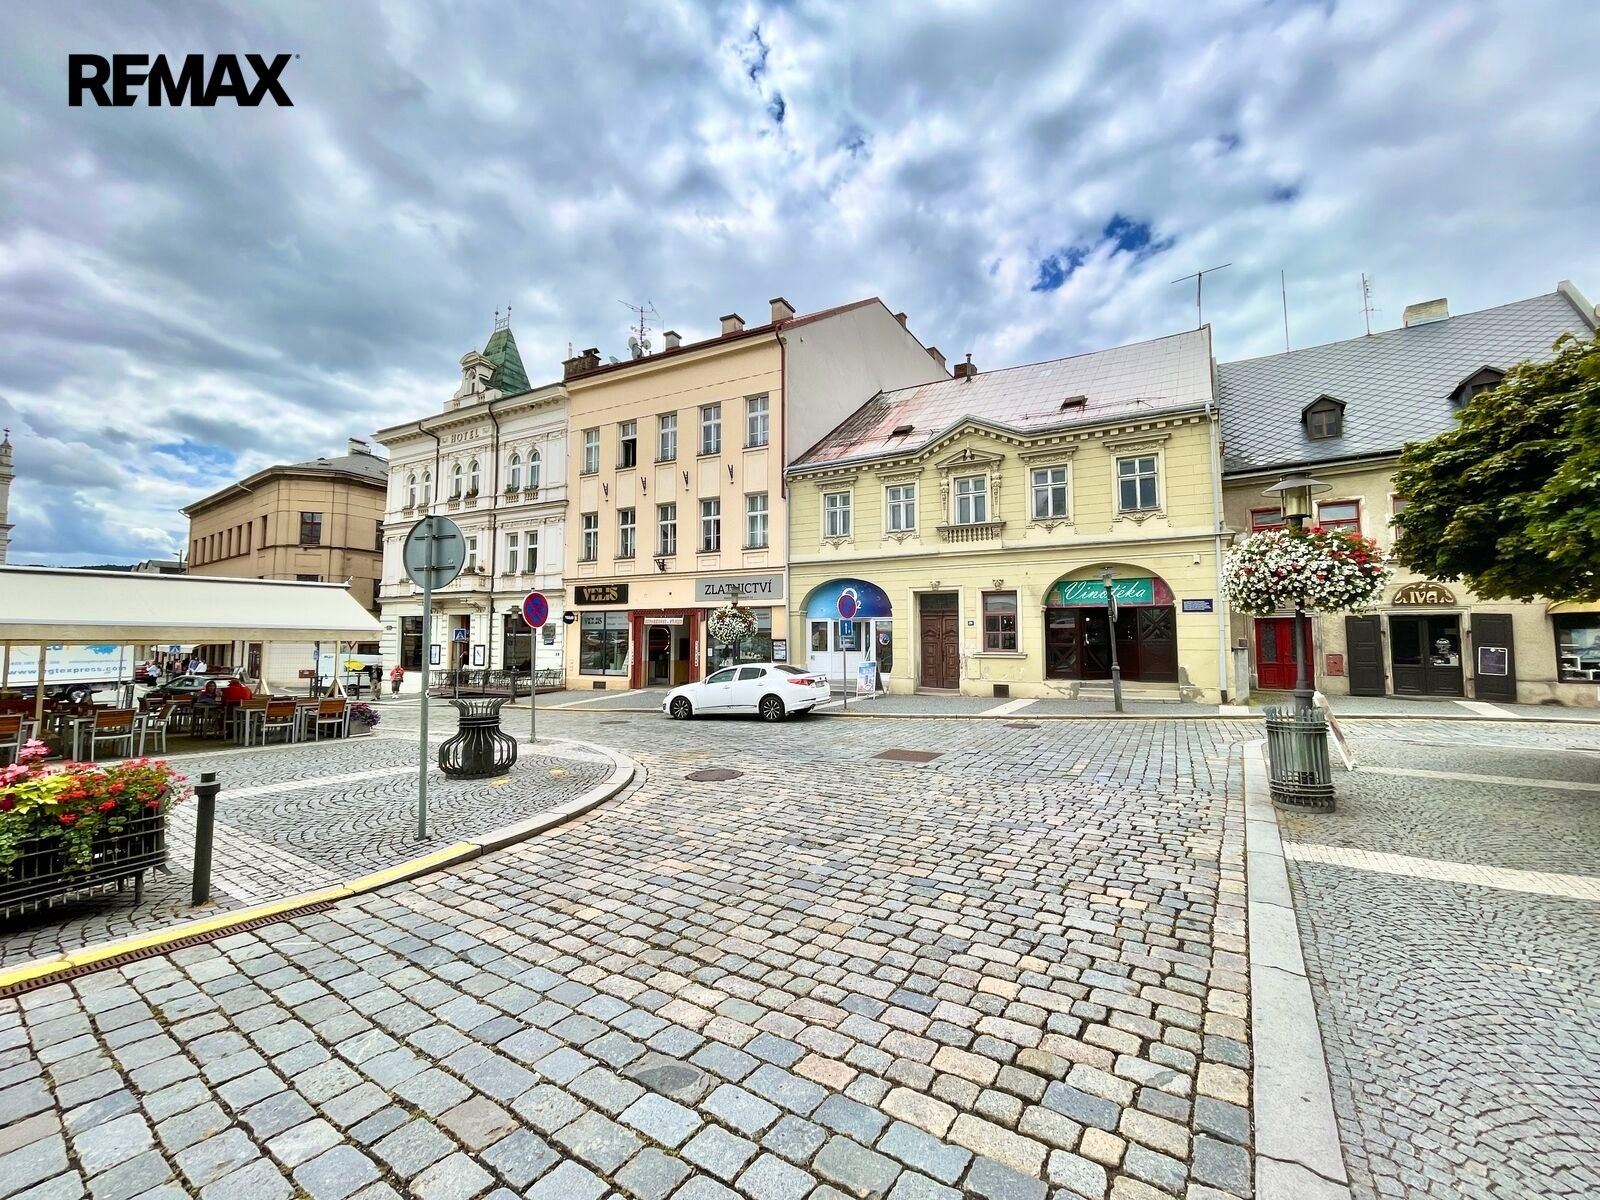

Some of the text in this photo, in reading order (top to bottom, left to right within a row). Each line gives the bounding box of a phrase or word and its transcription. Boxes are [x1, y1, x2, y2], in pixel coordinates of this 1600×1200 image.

[451, 428, 479, 443] HOTEL
[1064, 581, 1147, 600] Vinotéka
[1409, 591, 1438, 604] IVA
[8, 665, 127, 676] wwwgtexpress.com
